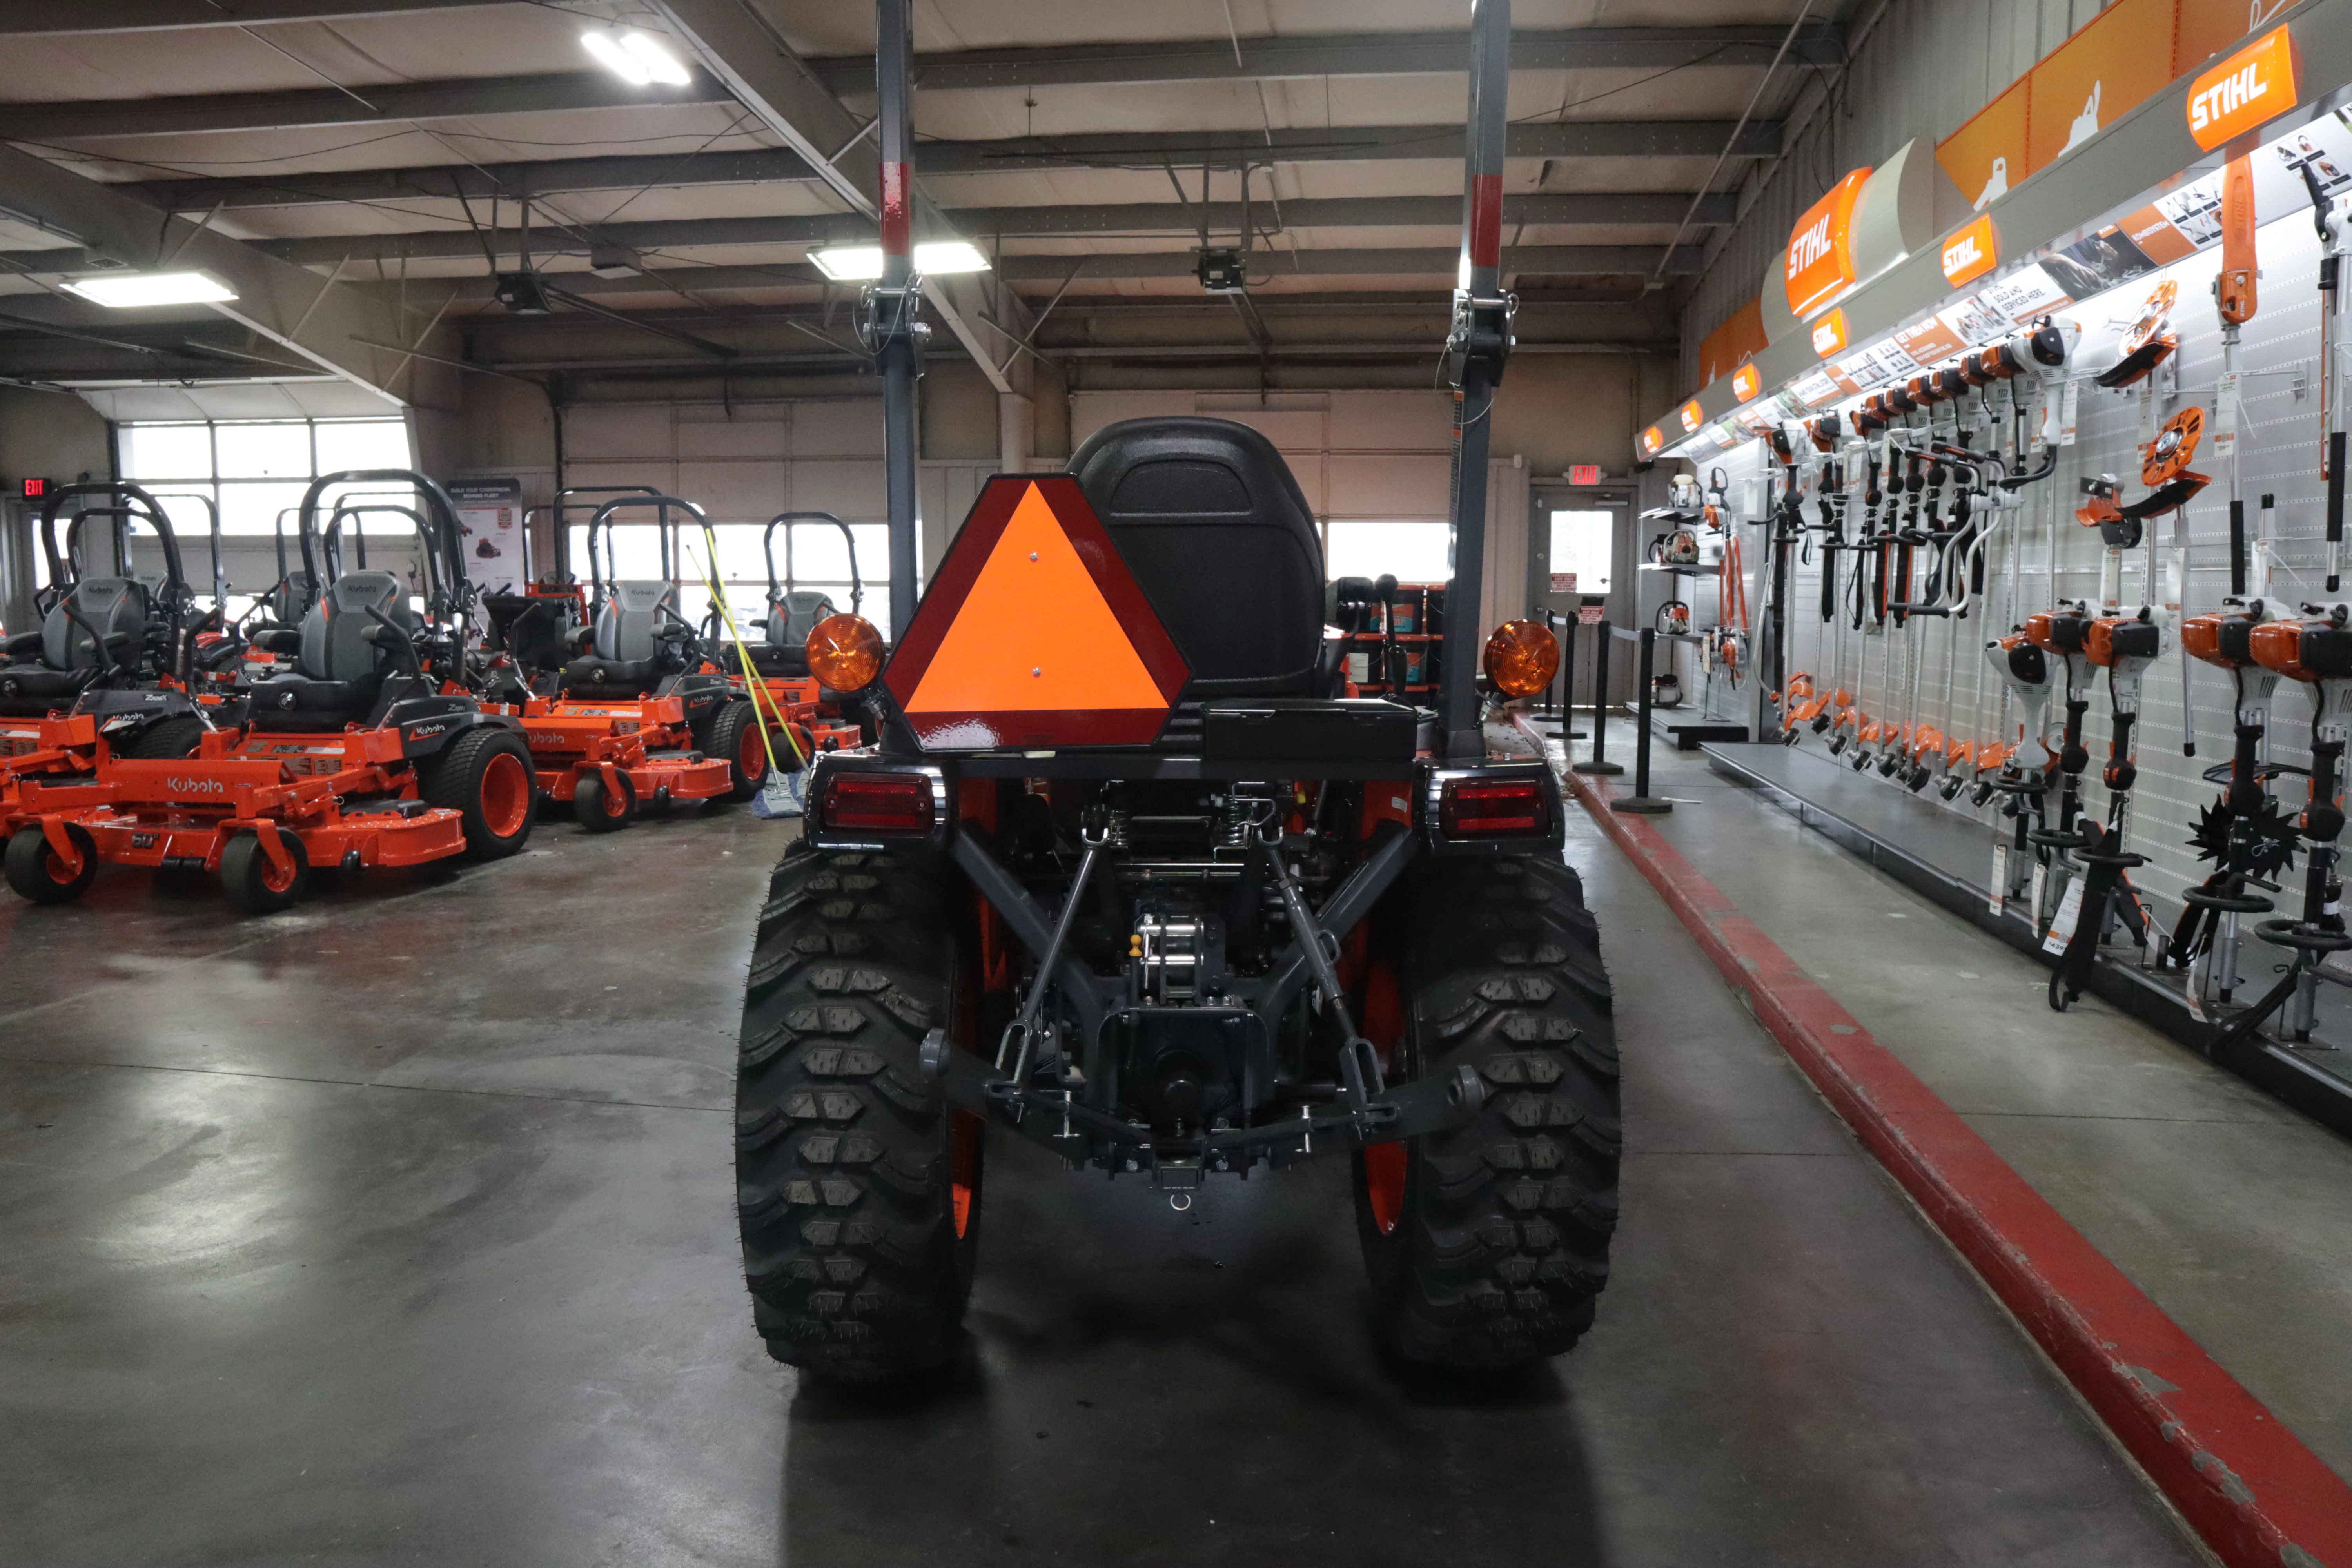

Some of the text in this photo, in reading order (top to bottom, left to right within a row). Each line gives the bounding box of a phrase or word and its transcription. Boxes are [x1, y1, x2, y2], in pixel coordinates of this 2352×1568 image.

[2192, 62, 2267, 131] STIHL
[2131, 220, 2171, 241] KOMBISYSTEM
[1788, 213, 1831, 281] STIHL
[1944, 236, 1982, 277] STIHL
[1994, 285, 2022, 303] SOLD AND
[2002, 298, 2029, 311] SERVICED
[1813, 323, 1839, 353] STIHL
[1894, 317, 1938, 343] GET THEM NOW
[1574, 466, 1597, 484] EXIT
[25, 479, 44, 495] EXIT
[416, 724, 445, 734] Kubota
[529, 732, 565, 744] ubota
[167, 777, 223, 793] Kubota
